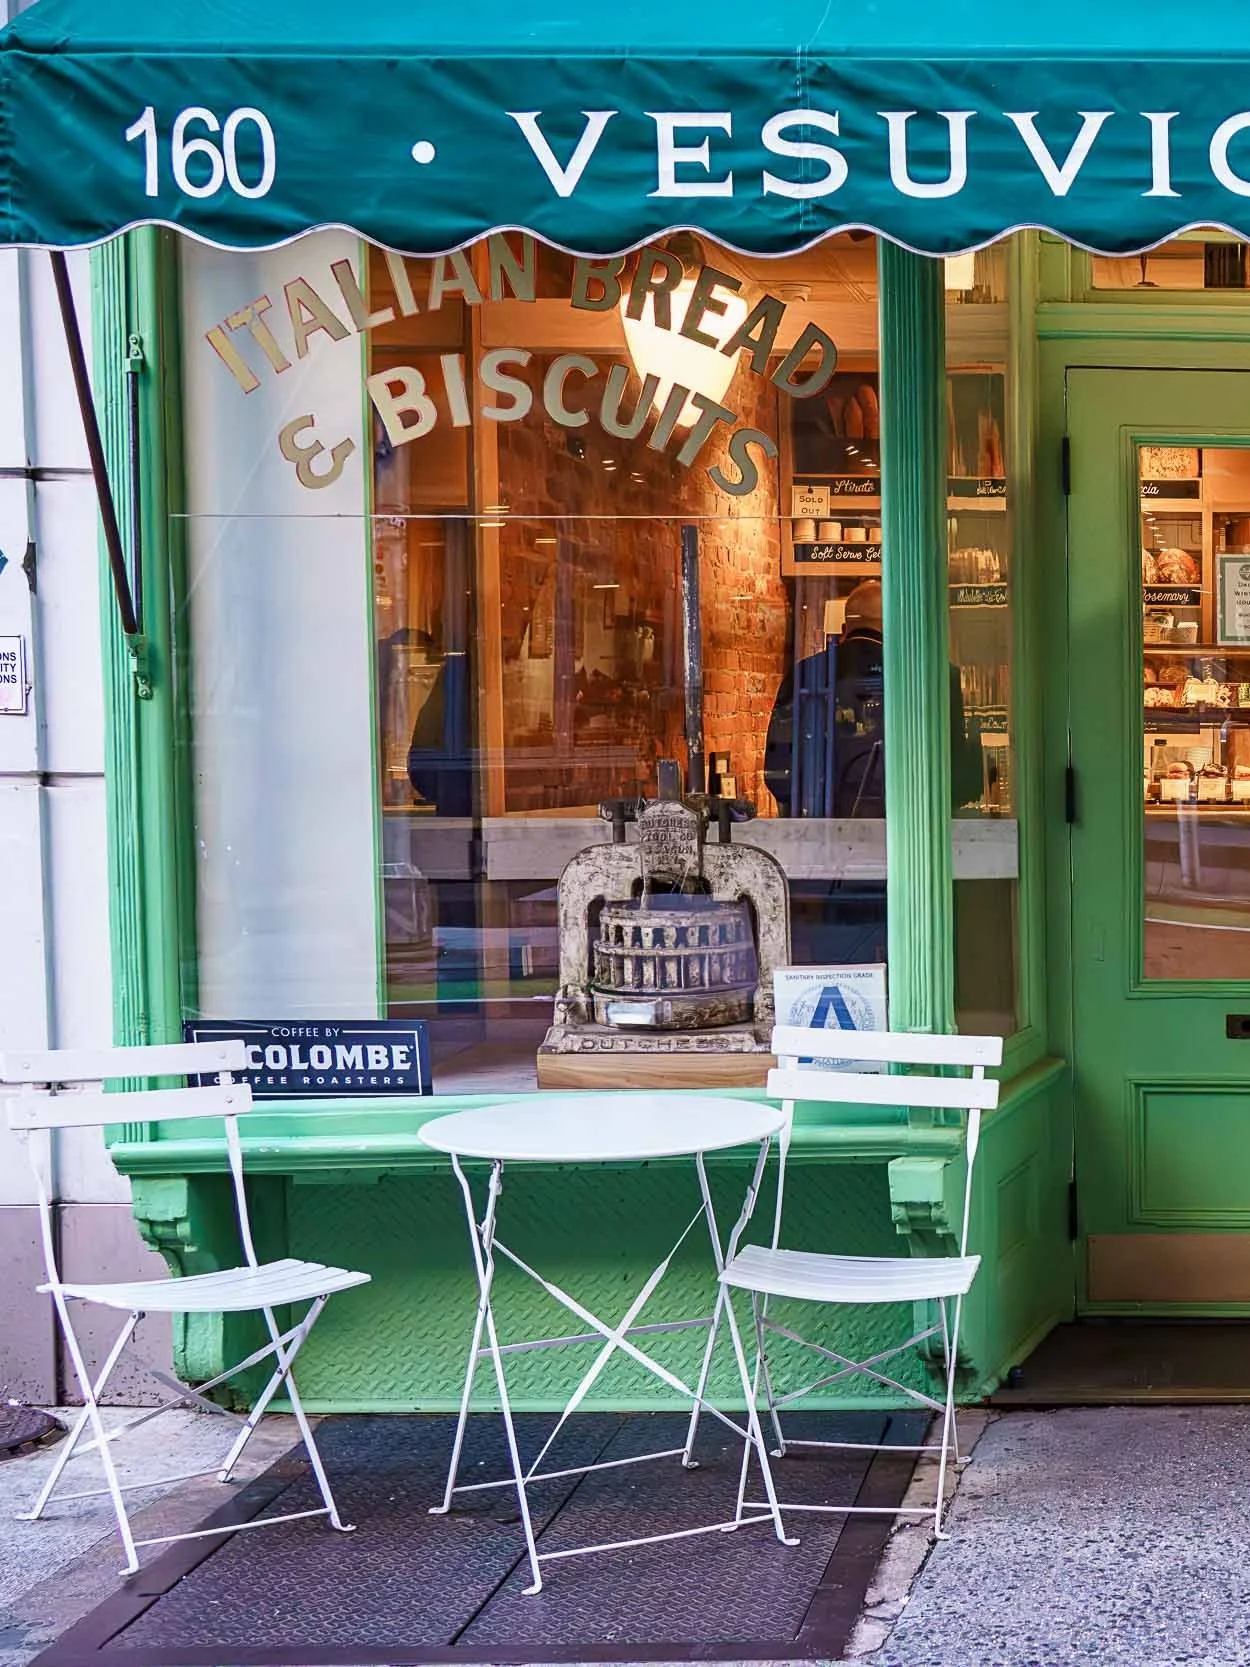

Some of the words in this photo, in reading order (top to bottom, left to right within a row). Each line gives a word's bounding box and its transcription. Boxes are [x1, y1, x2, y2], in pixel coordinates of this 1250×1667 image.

[125, 107, 276, 198] 160
[205, 230, 538, 395] ITALIAN
[571, 245, 838, 399] BREAD
[278, 414, 356, 490] &
[366, 347, 778, 496] BISCUITS
[799, 495, 824, 504] SOLD
[811, 546, 833, 561] Soft
[836, 546, 863, 560] Serve
[0, 652, 17, 662] NS
[271, 1027, 320, 1038] COFFEE
[325, 1027, 340, 1038] BY
[797, 986, 860, 1064] A
[246, 1044, 412, 1071] COLOMBE
[303, 1076, 405, 1085] ROASTERS
